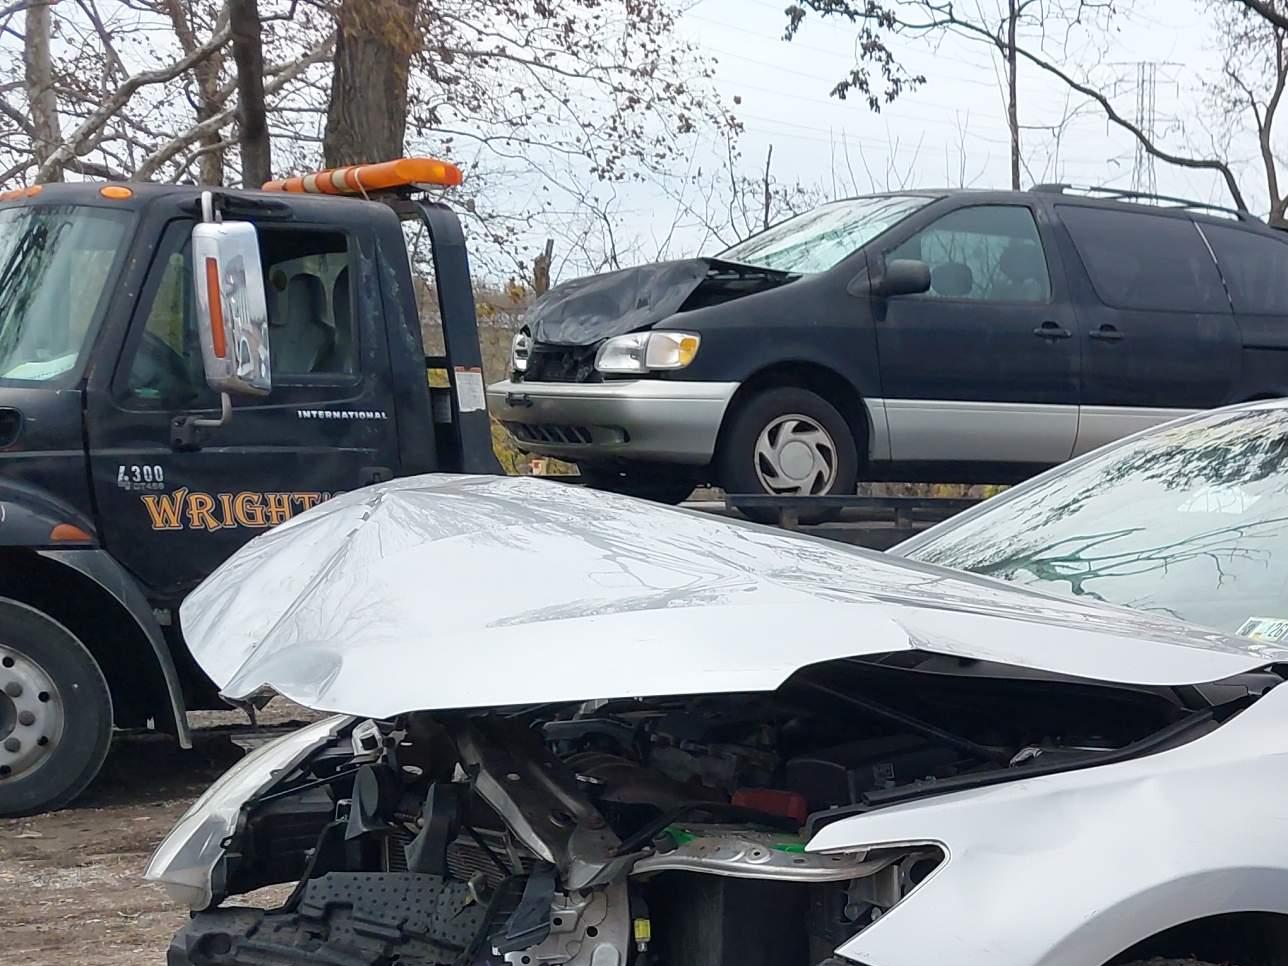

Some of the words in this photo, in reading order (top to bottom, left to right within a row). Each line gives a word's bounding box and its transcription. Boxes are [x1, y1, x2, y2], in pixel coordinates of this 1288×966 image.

[297, 410, 388, 420] INTERNATIONAL
[118, 465, 164, 490] 4300
[141, 487, 347, 531] WRIGHT'
